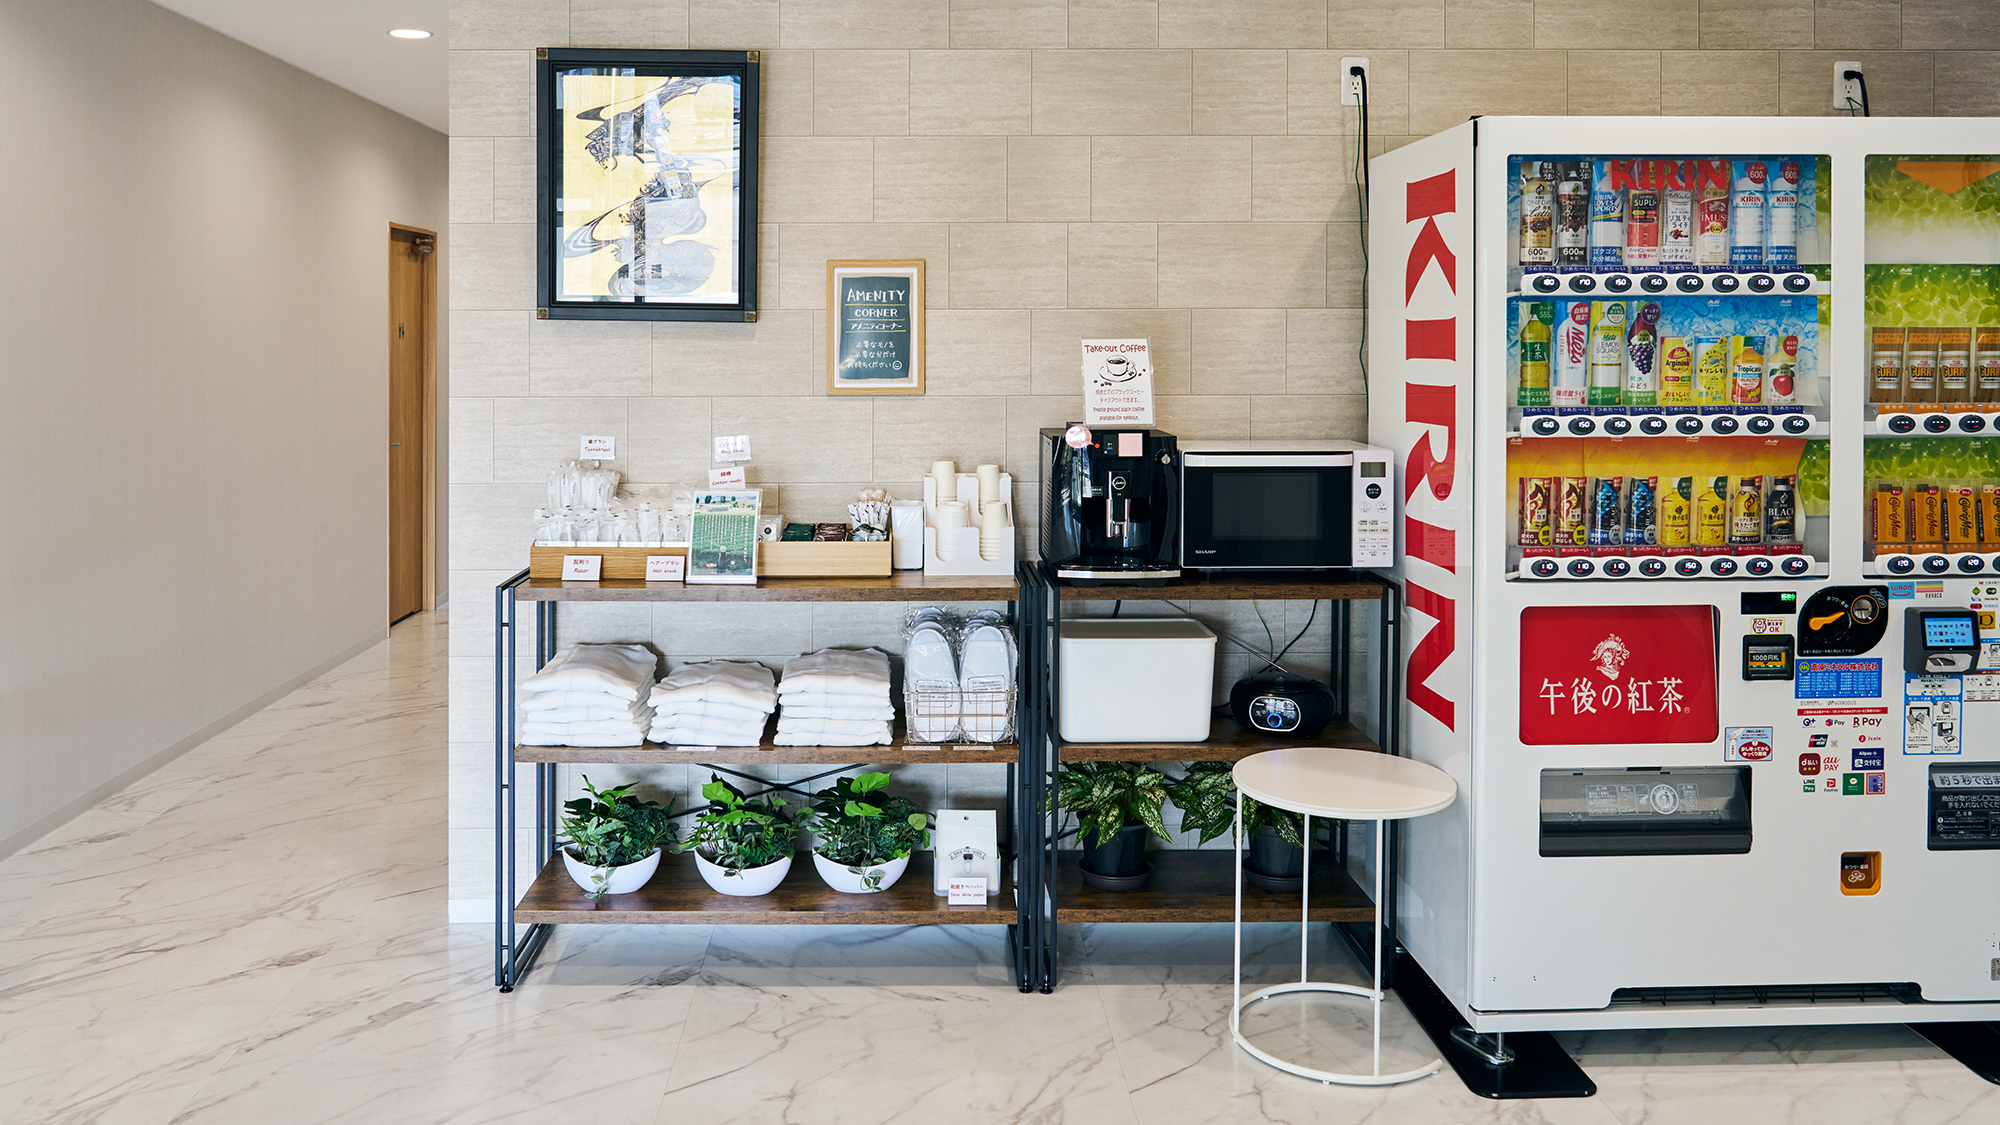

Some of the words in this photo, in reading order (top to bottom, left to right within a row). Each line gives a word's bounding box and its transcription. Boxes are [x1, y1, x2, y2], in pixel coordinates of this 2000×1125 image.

[1611, 159, 1727, 190] KIRIN
[847, 288, 906, 302] AMENITY
[854, 308, 898, 317] CORNER
[856, 341, 895, 349] 必要なモノを
[1084, 344, 1118, 353] Take-out
[1120, 344, 1146, 353] Coffee
[1571, 326, 1587, 364] Mets
[1533, 343, 1543, 360] 生茶
[848, 361, 892, 369] お持ちください
[1665, 359, 1689, 367] Arginine
[1737, 364, 1761, 373] Tropicana
[1555, 389, 1585, 397] 強炭酸ライチ
[1405, 167, 1457, 735] KIRIN
[1888, 496, 1901, 538] CalorieMate
[1926, 496, 1938, 538] CalorieMate
[1958, 497, 1972, 539] CalorieMate
[1811, 662, 1878, 672] 高原ミネラル株式会社
[1539, 677, 1684, 715] 午後の紅茶
[1862, 717, 1882, 727] Pay
[1823, 756, 1840, 764] au
[1938, 775, 2000, 786] 約5秒で出ま
